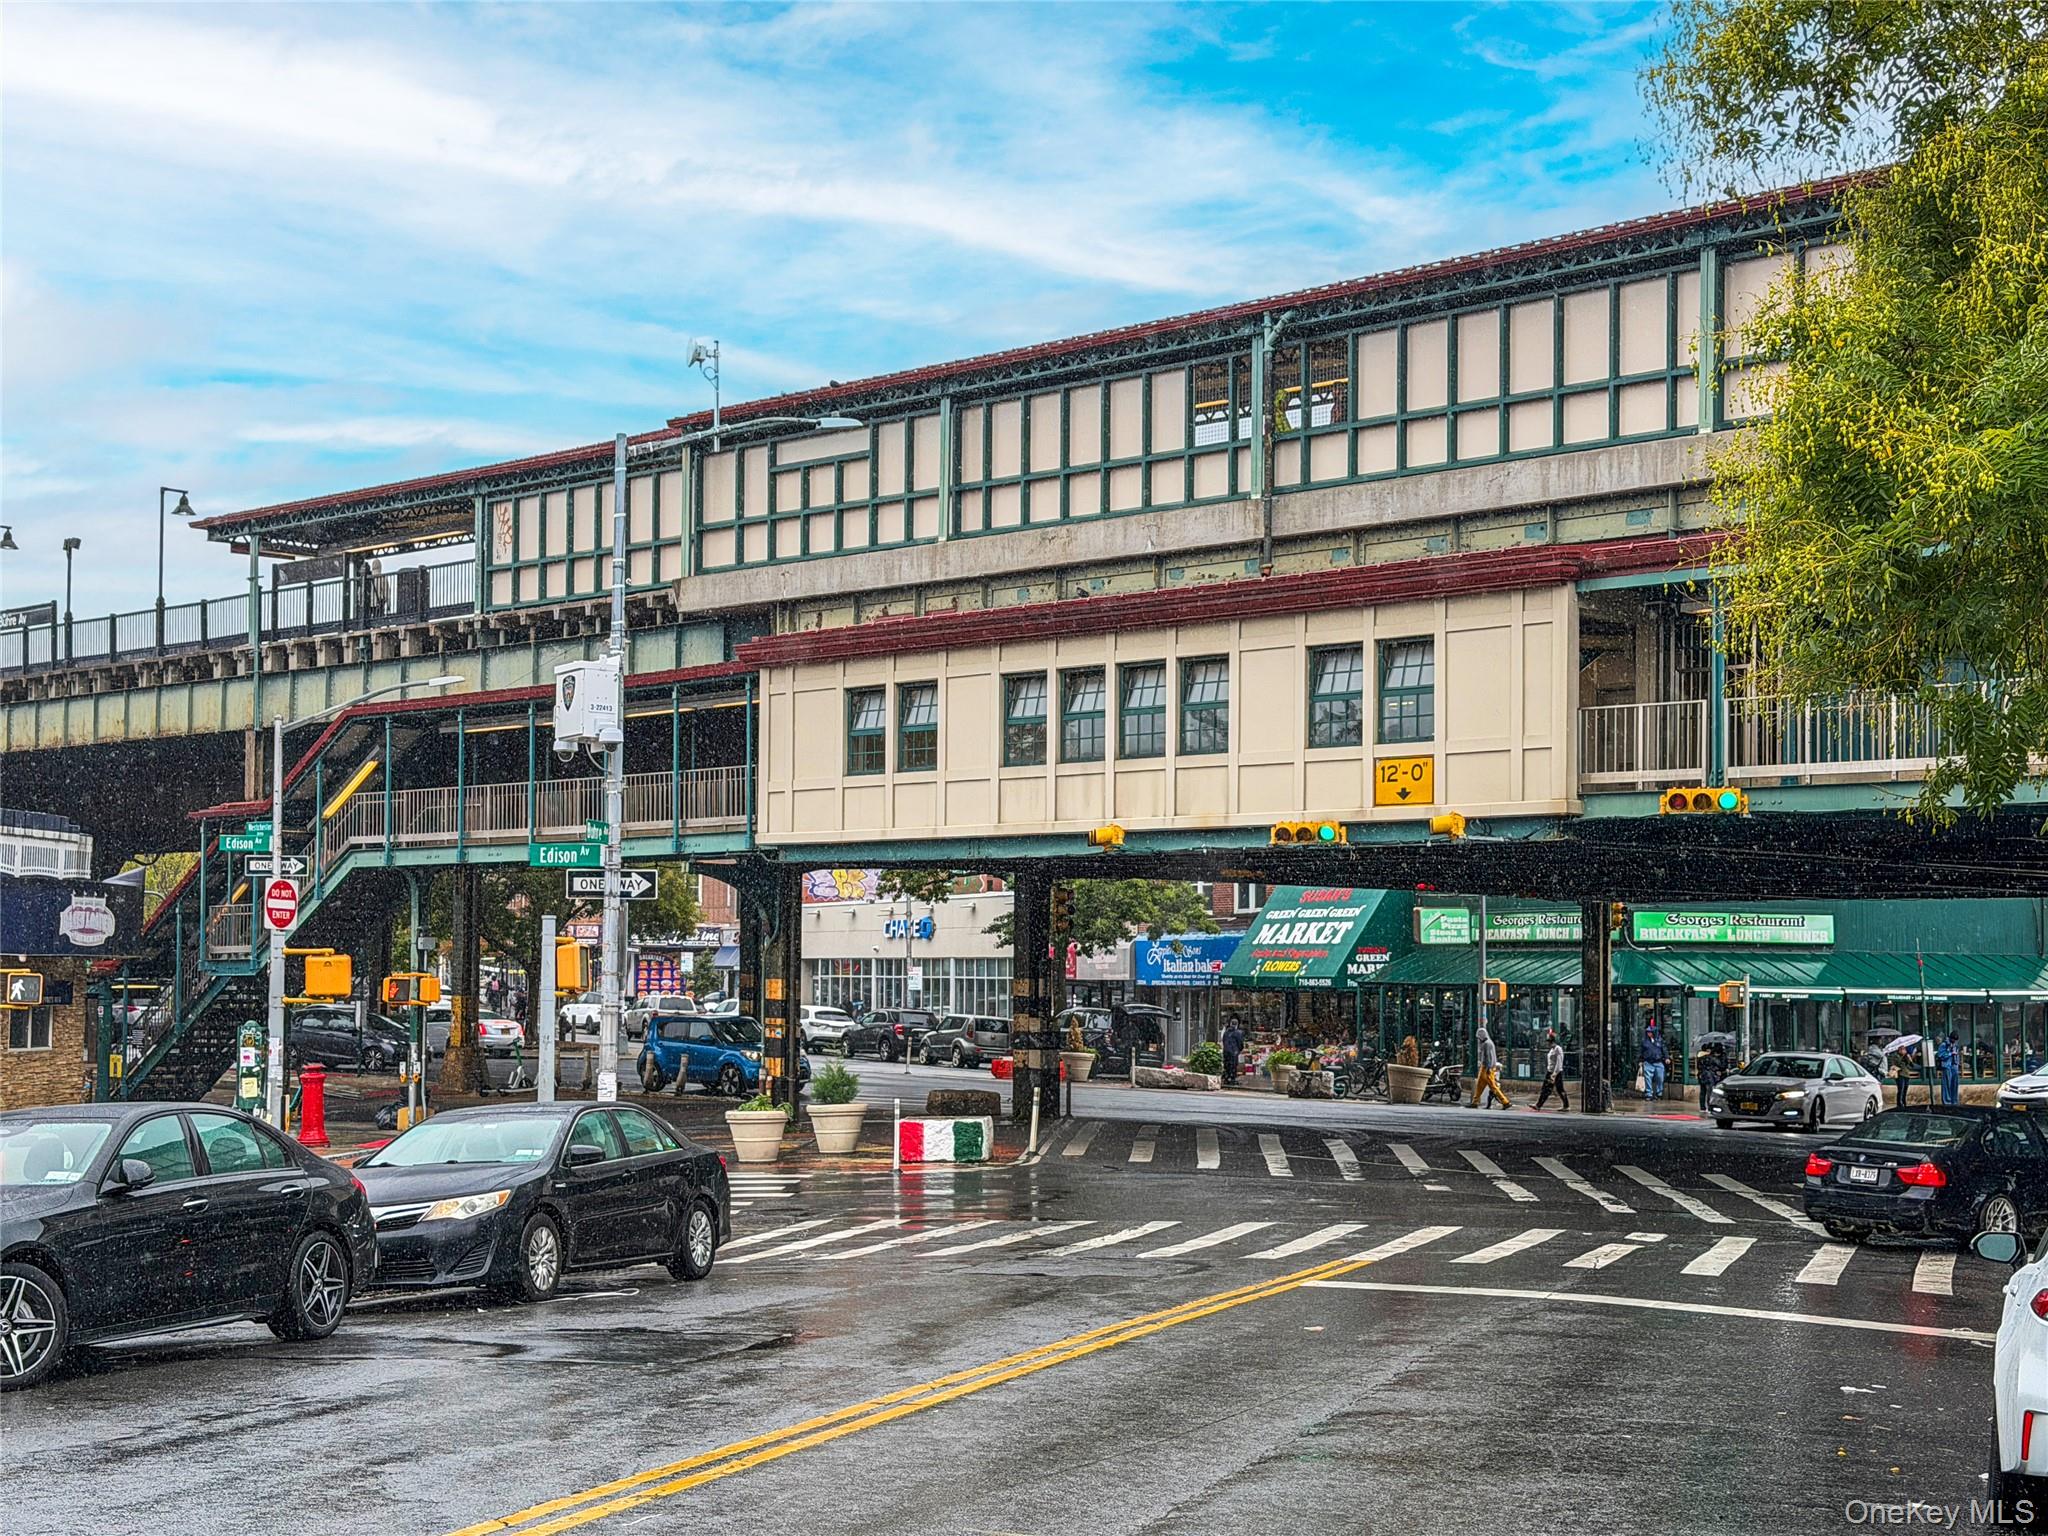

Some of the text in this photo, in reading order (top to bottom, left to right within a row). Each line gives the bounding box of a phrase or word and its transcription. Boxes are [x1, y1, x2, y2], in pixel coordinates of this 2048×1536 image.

[226, 837, 253, 849] Edison
[540, 845, 590, 863] Edison Av
[254, 862, 272, 870] ONE
[580, 879, 643, 890] ONE WAY
[271, 889, 292, 898] DO NOT
[272, 910, 290, 919] ENTER
[1265, 905, 1367, 919] GREEN GREEN GREEN
[1493, 914, 1582, 927] Georges Restaur
[1664, 913, 1806, 928] Georges Restaurant
[883, 918, 921, 939] CHAE
[1252, 921, 1354, 945] MARKET
[1475, 928, 1529, 940] BEAKFAST
[1536, 928, 1570, 940] LUNCH
[1639, 928, 1829, 942] BREAKFAST LUNCH DINNER
[1355, 952, 1392, 962] GREEN
[1163, 958, 1194, 973] Italian
[1261, 961, 1302, 972] FLOWERS
[1347, 963, 1388, 975] MARK
